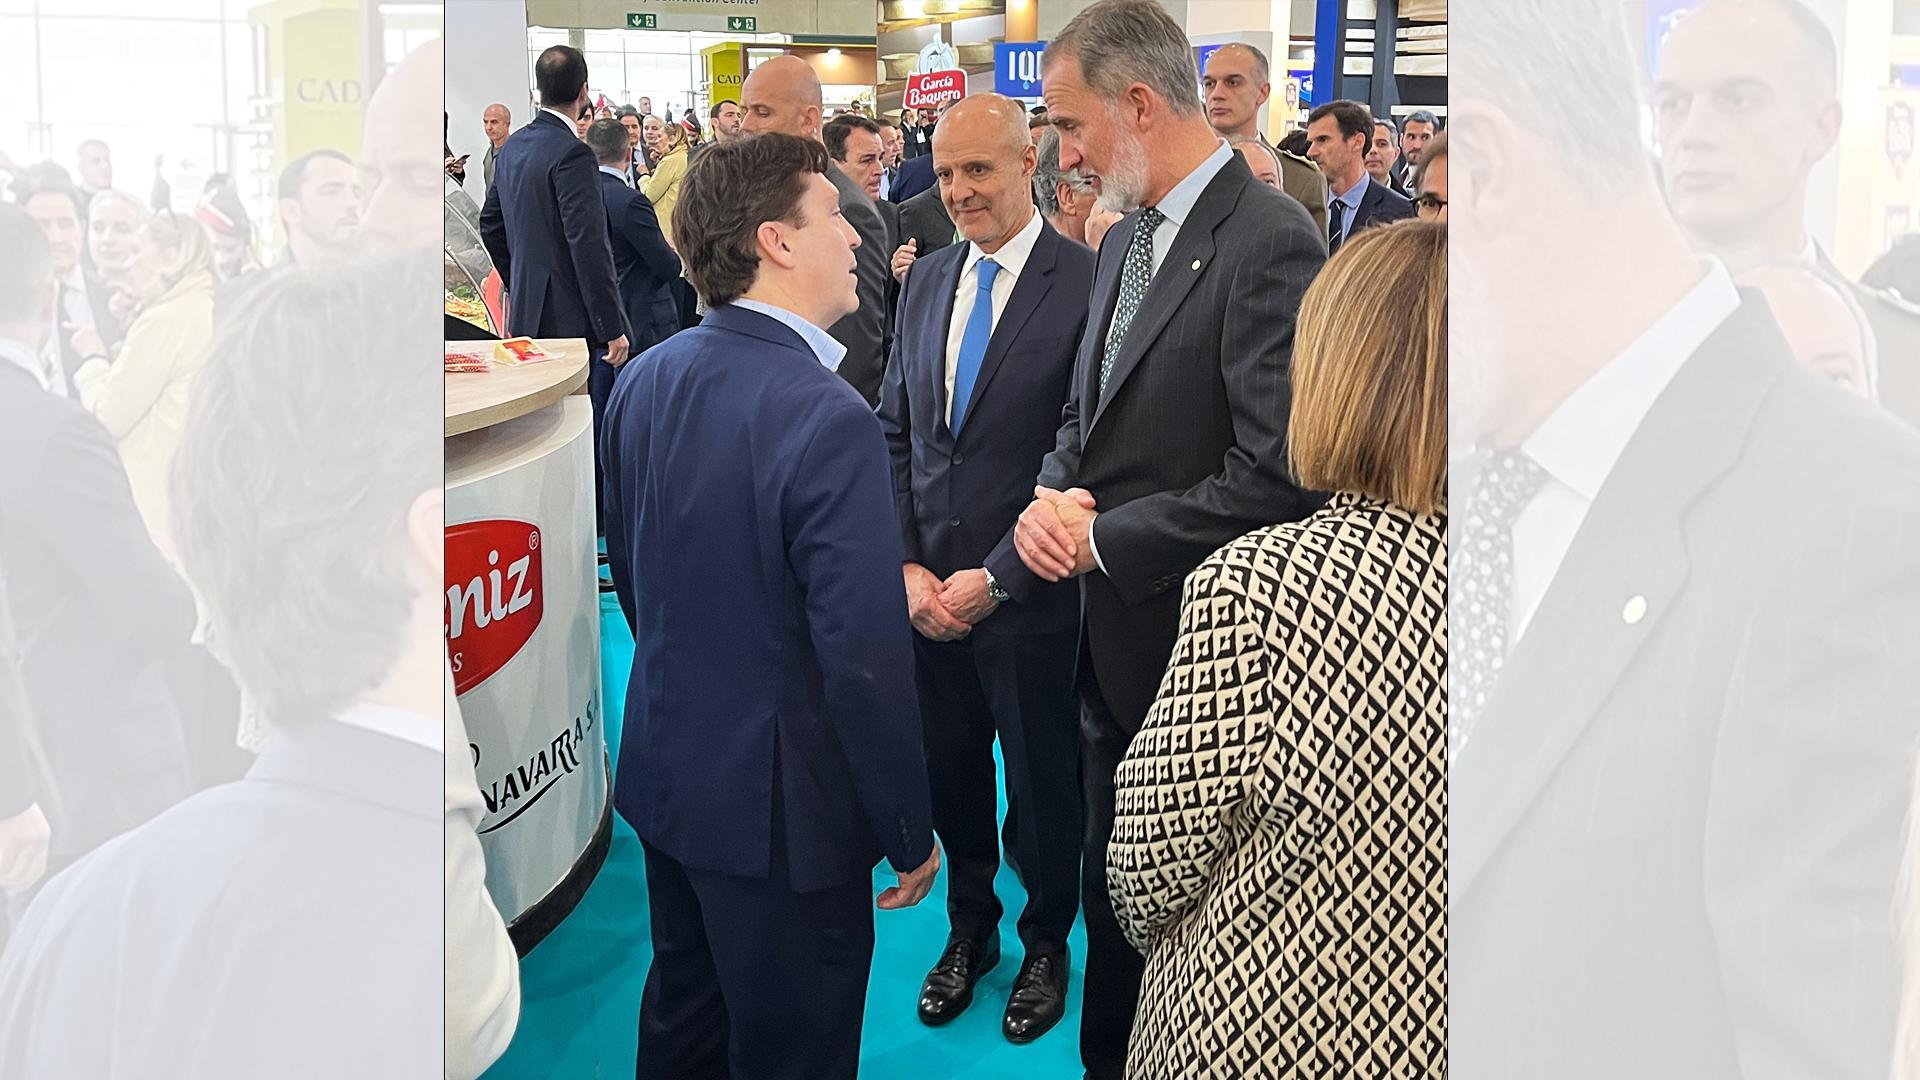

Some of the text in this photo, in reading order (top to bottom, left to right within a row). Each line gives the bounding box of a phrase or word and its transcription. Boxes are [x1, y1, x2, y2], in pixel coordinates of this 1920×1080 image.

[920, 76, 953, 91] García
[909, 88, 961, 105] Baquero
[445, 550, 533, 639] niz
